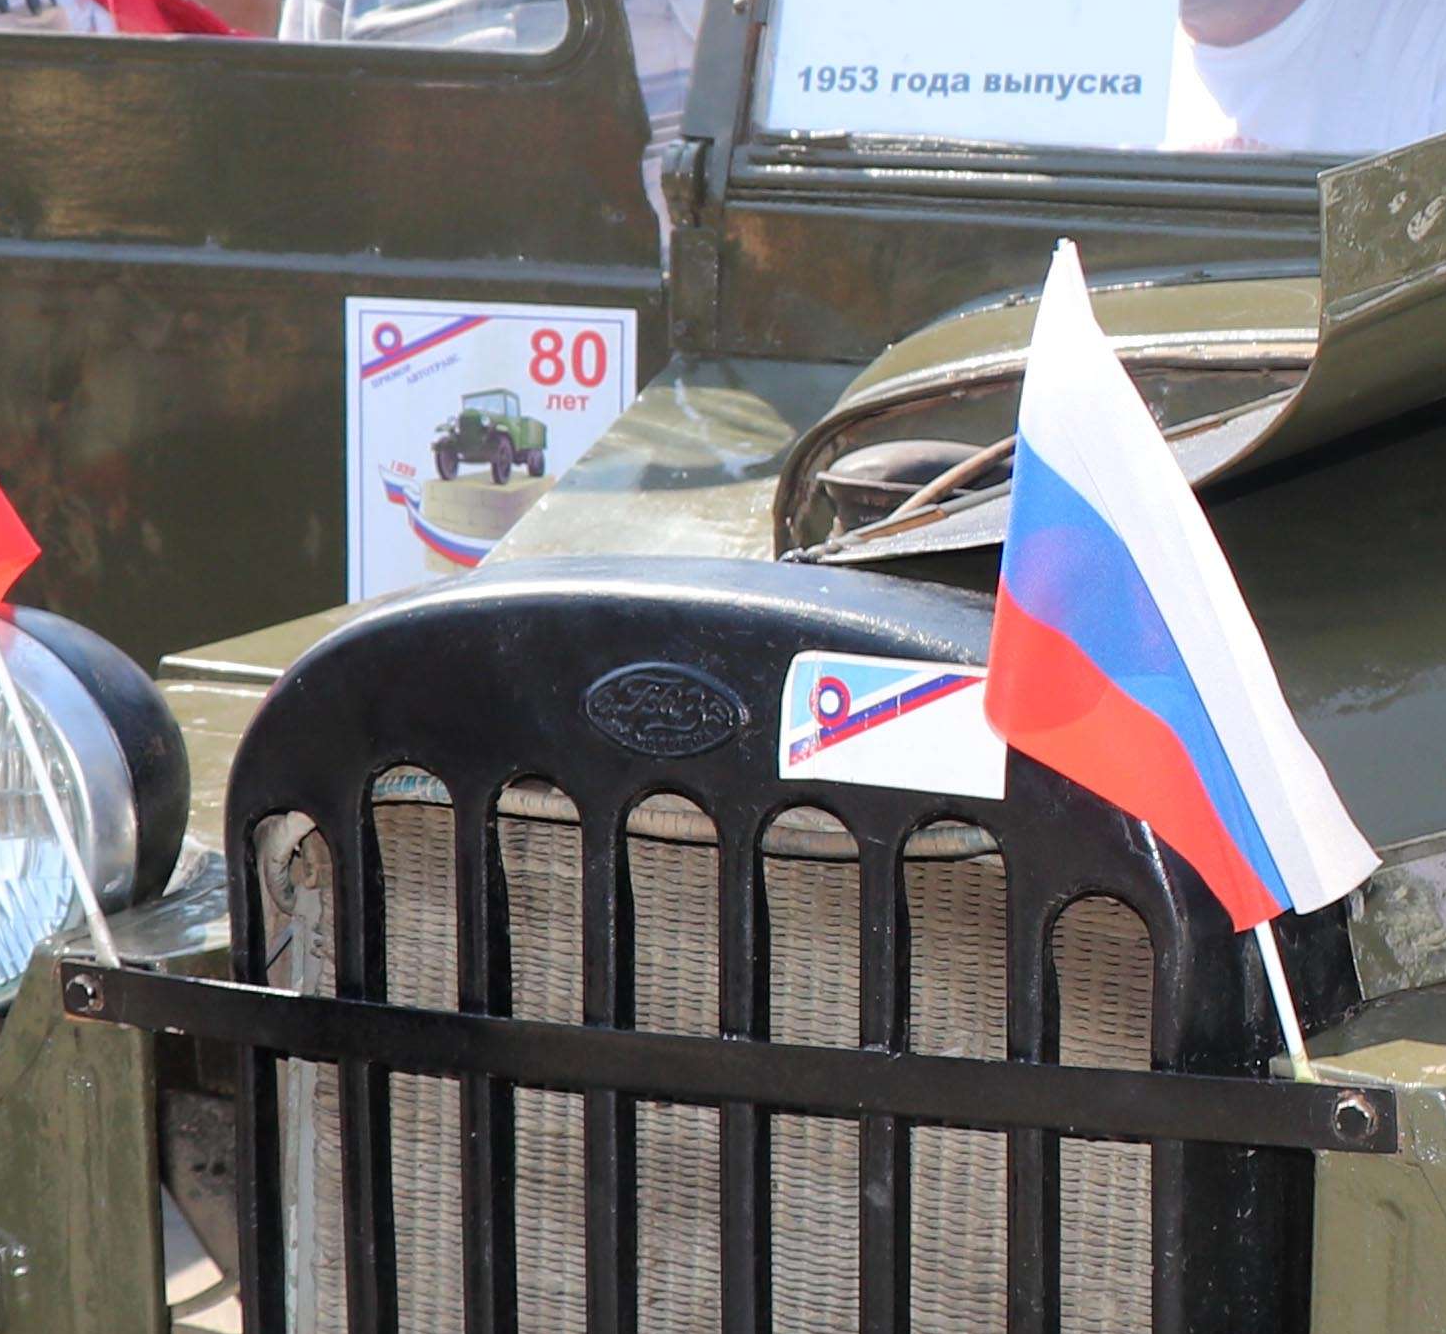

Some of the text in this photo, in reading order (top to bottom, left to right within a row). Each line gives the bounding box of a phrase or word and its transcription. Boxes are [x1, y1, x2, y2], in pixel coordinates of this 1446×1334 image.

[797, 66, 1143, 101] 1953 года выпуска
[529, 327, 608, 388] 80
[545, 390, 590, 412] лет
